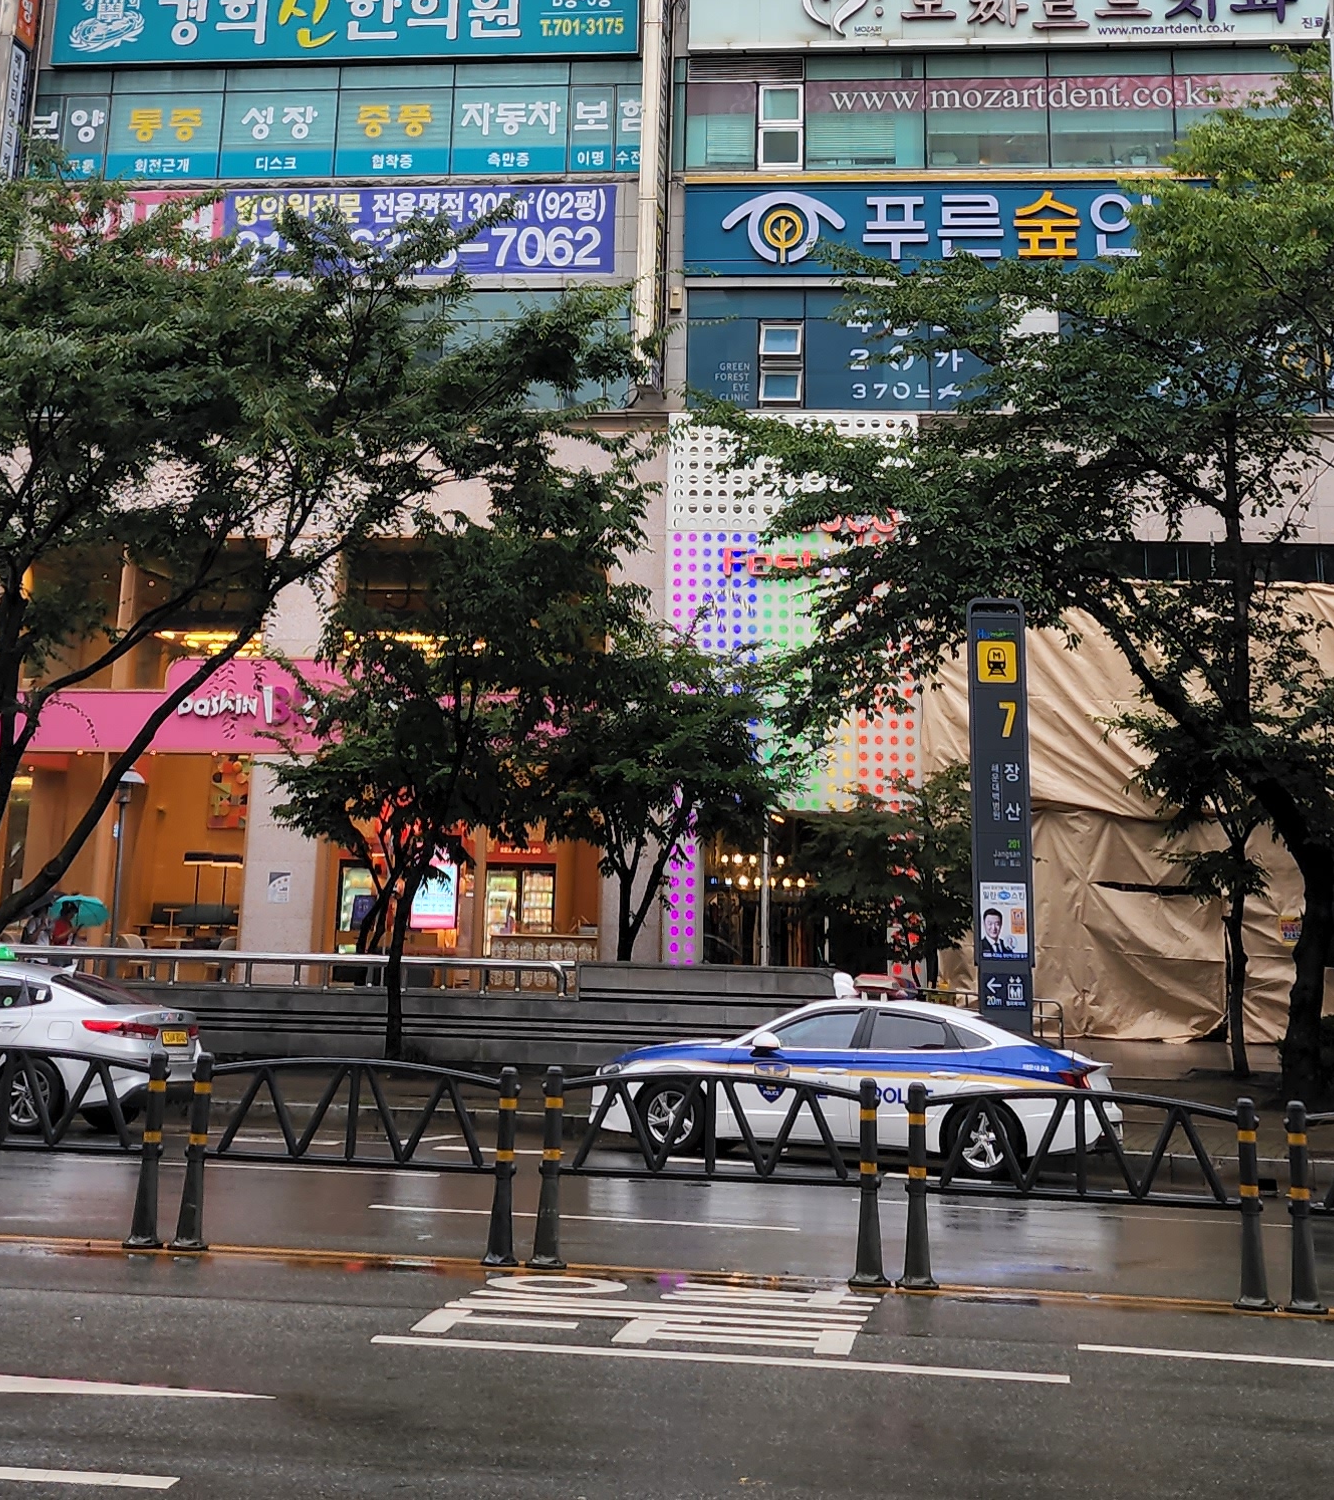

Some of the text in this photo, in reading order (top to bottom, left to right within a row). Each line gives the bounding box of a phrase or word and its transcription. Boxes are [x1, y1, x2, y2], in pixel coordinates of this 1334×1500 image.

[1097, 21, 1236, 38] www.mozartdent.co.kr
[128, 107, 203, 143] 통증
[241, 104, 319, 141] 성장
[461, 99, 562, 136] 자동차
[133, 157, 190, 174] 회전근개
[255, 156, 298, 172] 디스크
[371, 153, 414, 171] 협착증
[486, 151, 530, 168] 측만증
[577, 150, 605, 167] 이명
[536, 189, 607, 222] (92평)
[718, 362, 750, 371] GREEN
[714, 372, 749, 382] FOREST
[732, 382, 750, 392] EYE
[718, 392, 750, 402] CLINIC
[997, 701, 1017, 738] 7
[1003, 762, 1022, 822] 장산
